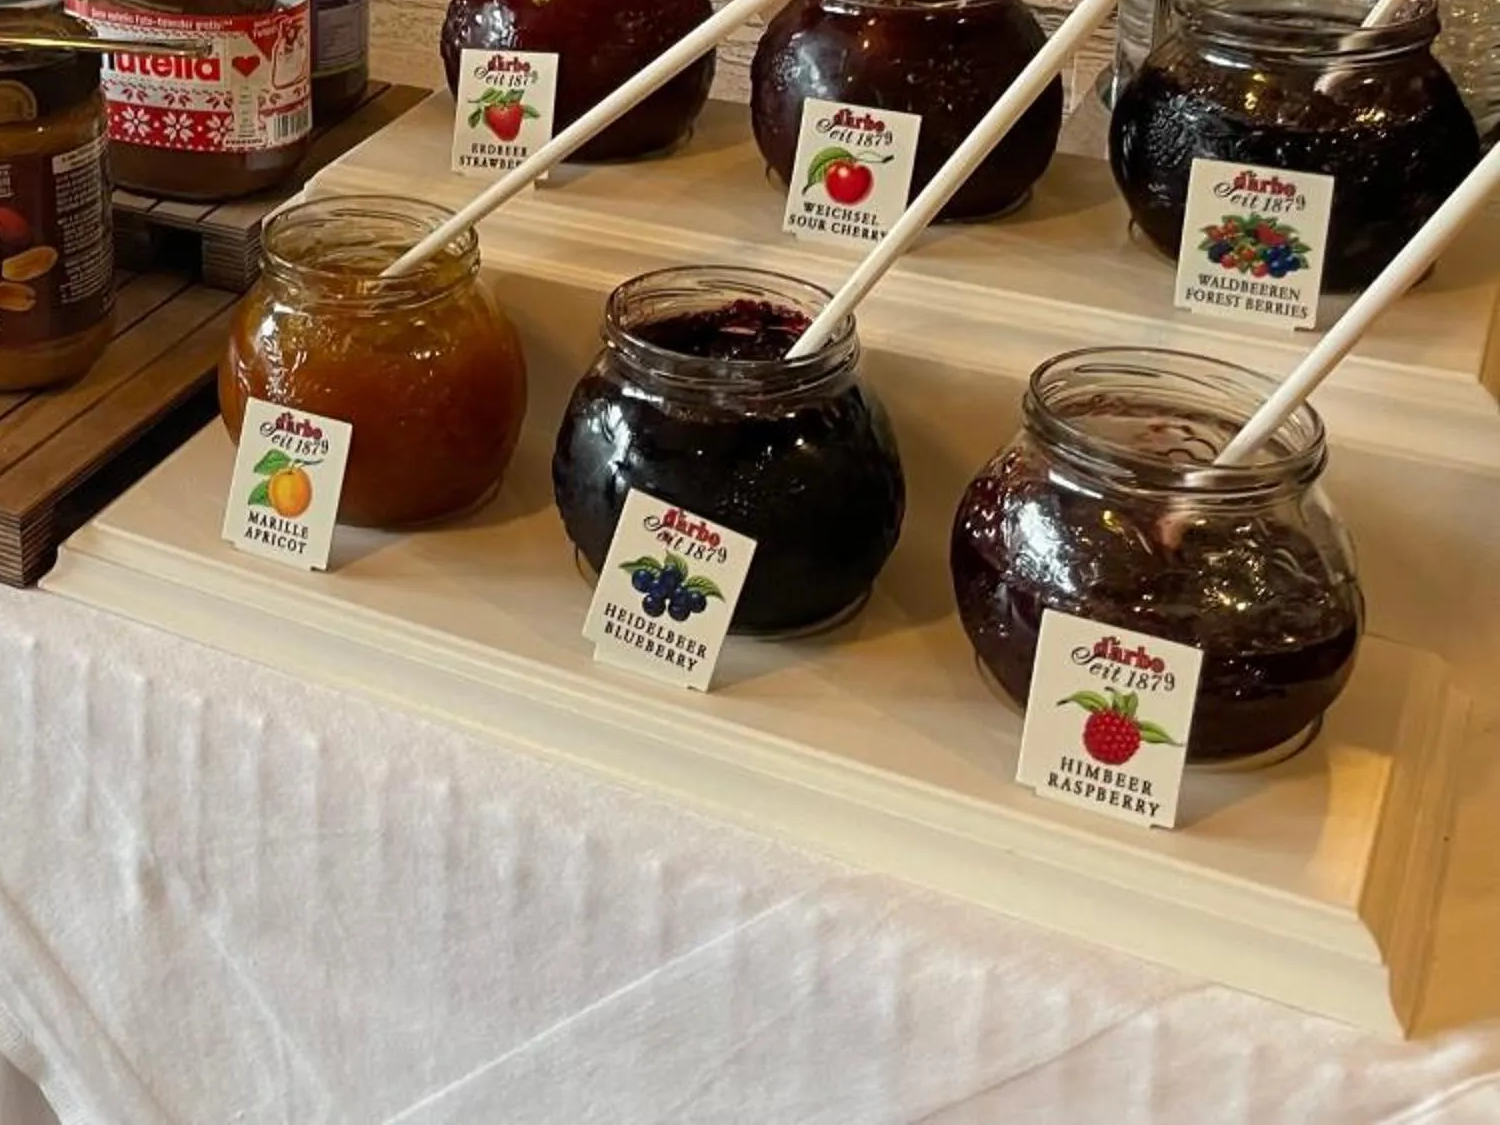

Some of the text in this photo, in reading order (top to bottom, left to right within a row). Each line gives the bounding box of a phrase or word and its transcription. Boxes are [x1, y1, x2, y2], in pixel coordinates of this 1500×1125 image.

[109, 52, 221, 82] utella
[855, 131, 894, 147] 1879
[1213, 182, 1307, 213] Seit 1879
[788, 214, 827, 232] SOUR
[803, 201, 880, 227] WEICHSEL
[1198, 273, 1301, 302] WALDBEEREN
[1185, 286, 1310, 320] FOREST BERRIES
[295, 438, 329, 456] 1879
[247, 510, 309, 539] MARILLE
[244, 526, 307, 554] APRICOT
[684, 539, 728, 564] 1879
[603, 602, 708, 659] HEIDELBEER
[604, 620, 699, 673] BLUEBERRY
[1071, 646, 1176, 693] Seit 1879
[1060, 756, 1154, 797] HIMBEER
[1048, 771, 1161, 818] RASPBERRY
